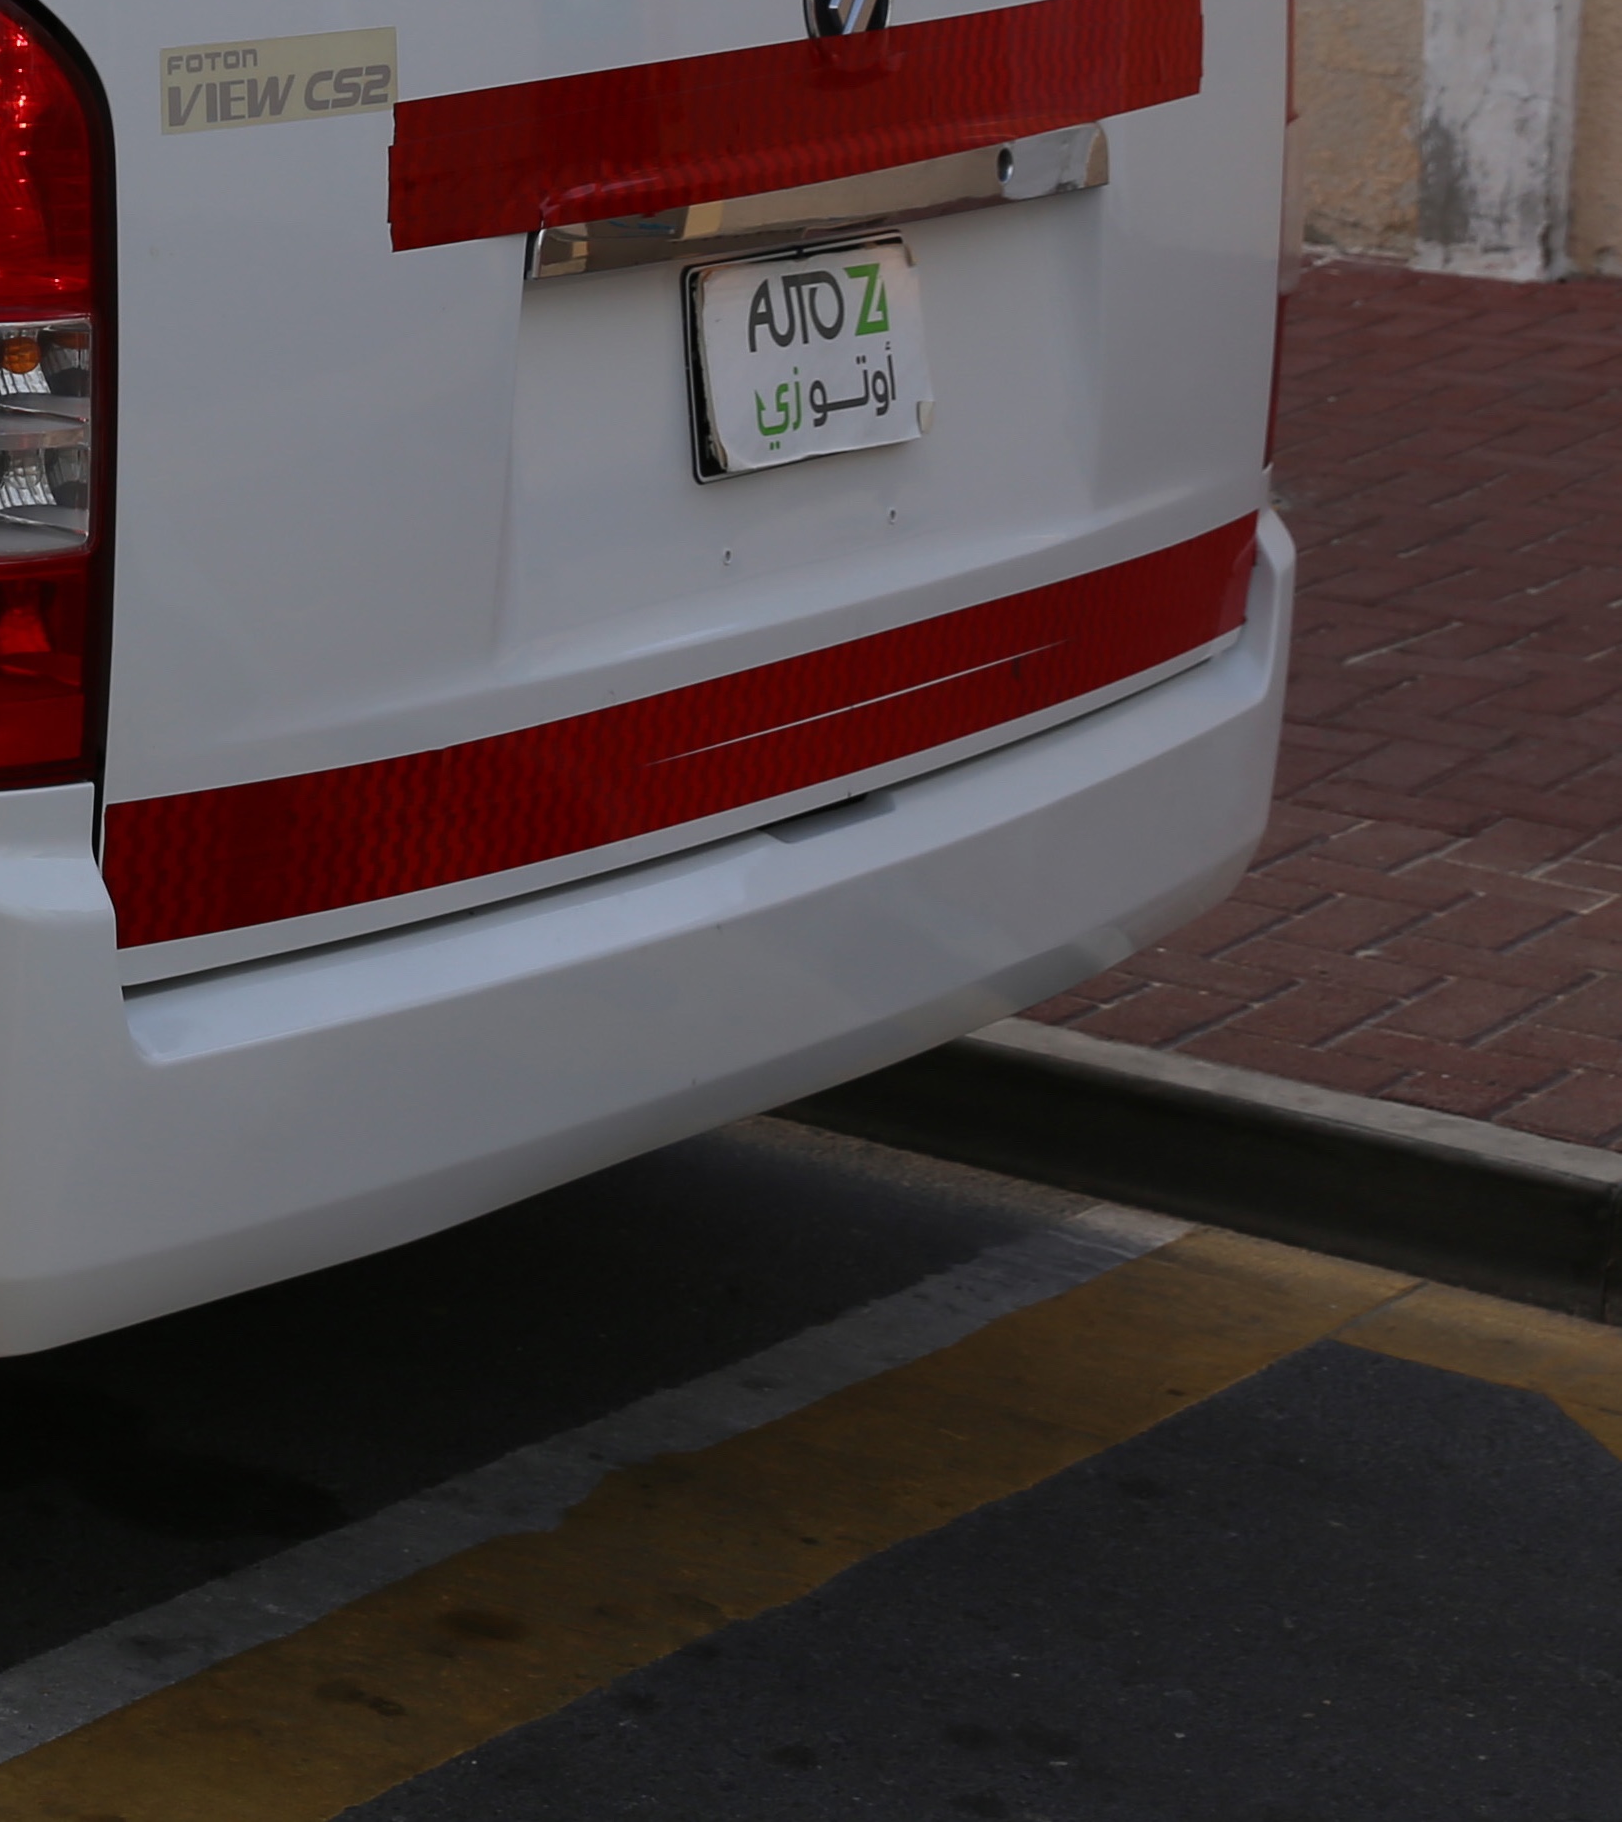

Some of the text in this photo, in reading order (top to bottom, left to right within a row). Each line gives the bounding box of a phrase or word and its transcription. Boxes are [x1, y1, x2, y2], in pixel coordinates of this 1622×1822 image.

[167, 49, 258, 76] FOTON
[168, 64, 392, 127] VIEW CS2
[748, 270, 845, 353] AUTO
